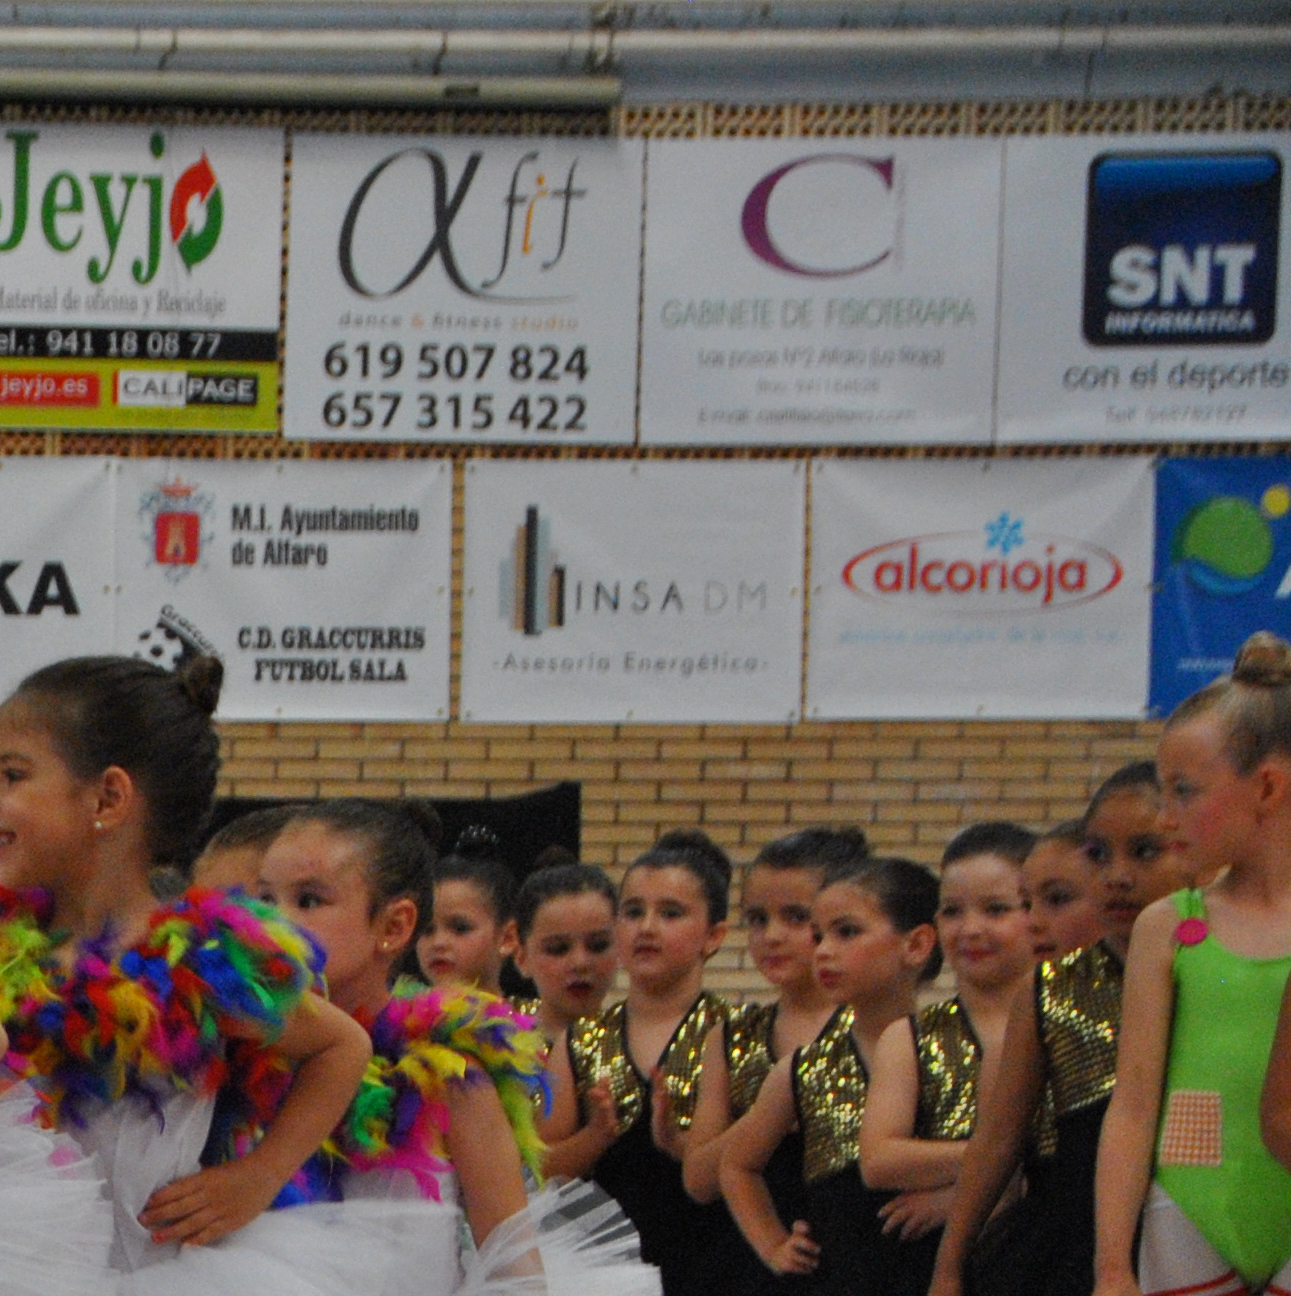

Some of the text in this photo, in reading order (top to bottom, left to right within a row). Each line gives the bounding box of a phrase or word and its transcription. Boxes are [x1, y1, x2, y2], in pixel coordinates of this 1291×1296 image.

[1106, 243, 1256, 308] SNT
[63, 289, 80, 312] de
[142, 298, 151, 317] y
[660, 300, 773, 328] GABINETE
[780, 300, 813, 328] DE
[46, 331, 93, 351] 941
[108, 331, 138, 352] 18
[147, 331, 179, 354] 08
[188, 333, 221, 357] 77
[323, 341, 589, 381] 619 507 824
[1063, 360, 1289, 395] con el deporte
[322, 391, 588, 431] 657 315 422
[231, 503, 419, 535] M.I. Ayuntamiento
[232, 540, 328, 567] de Alfaro
[873, 541, 1089, 604] alcorioja
[574, 579, 768, 613] INSA DM
[238, 626, 426, 650] C.D. GRACCURRIS
[255, 658, 408, 681] FUTBOL SALA
